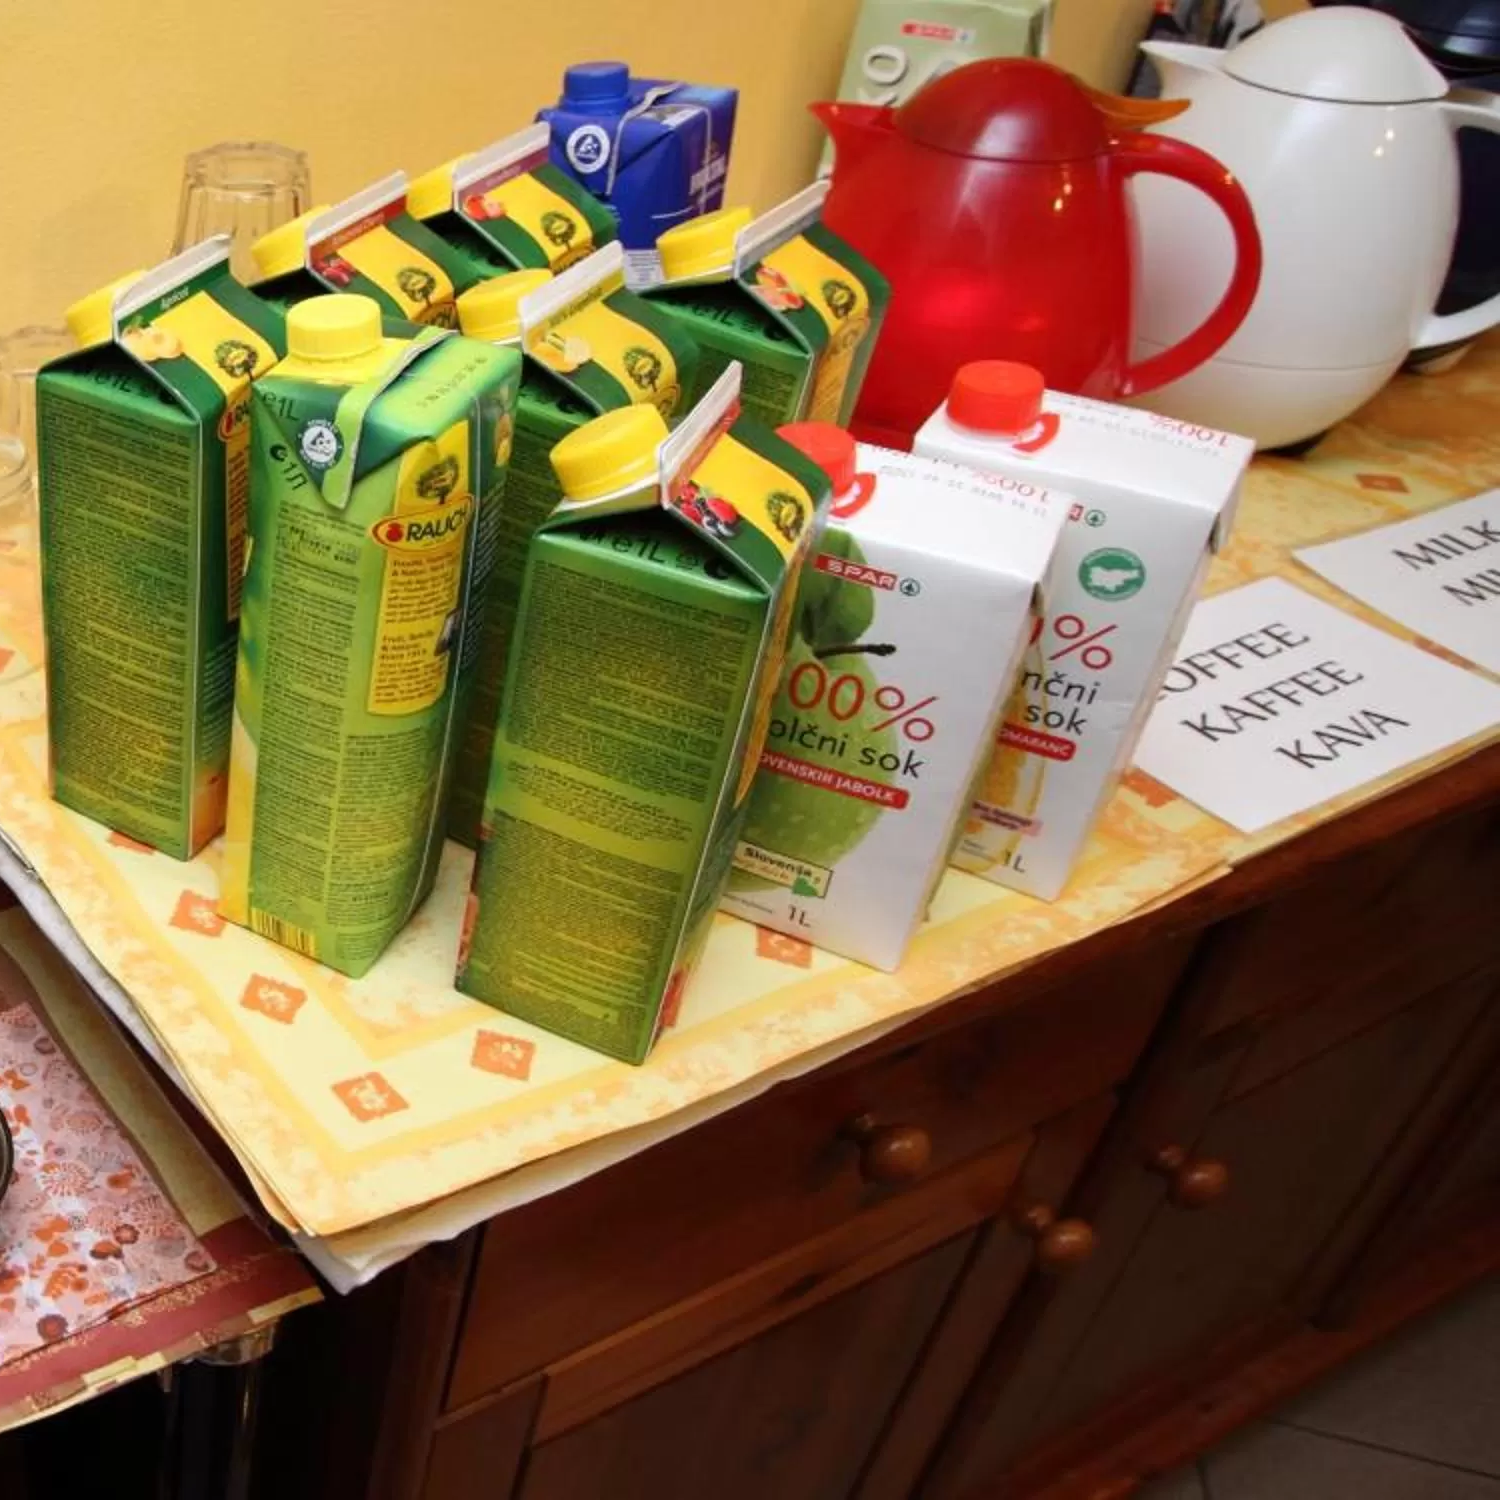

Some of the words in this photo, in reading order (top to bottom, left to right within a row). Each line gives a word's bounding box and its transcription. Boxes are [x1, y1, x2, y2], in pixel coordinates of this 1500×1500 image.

[1392, 520, 1500, 571] MILK
[826, 556, 896, 591] SPAR
[1160, 622, 1311, 700] OFFEE
[788, 661, 939, 742] 00%
[1023, 704, 1088, 736] sok
[1180, 660, 1365, 742] KAFFEE
[858, 744, 927, 780] sok
[1274, 708, 1411, 769] KAVA
[787, 904, 812, 929] 1L
